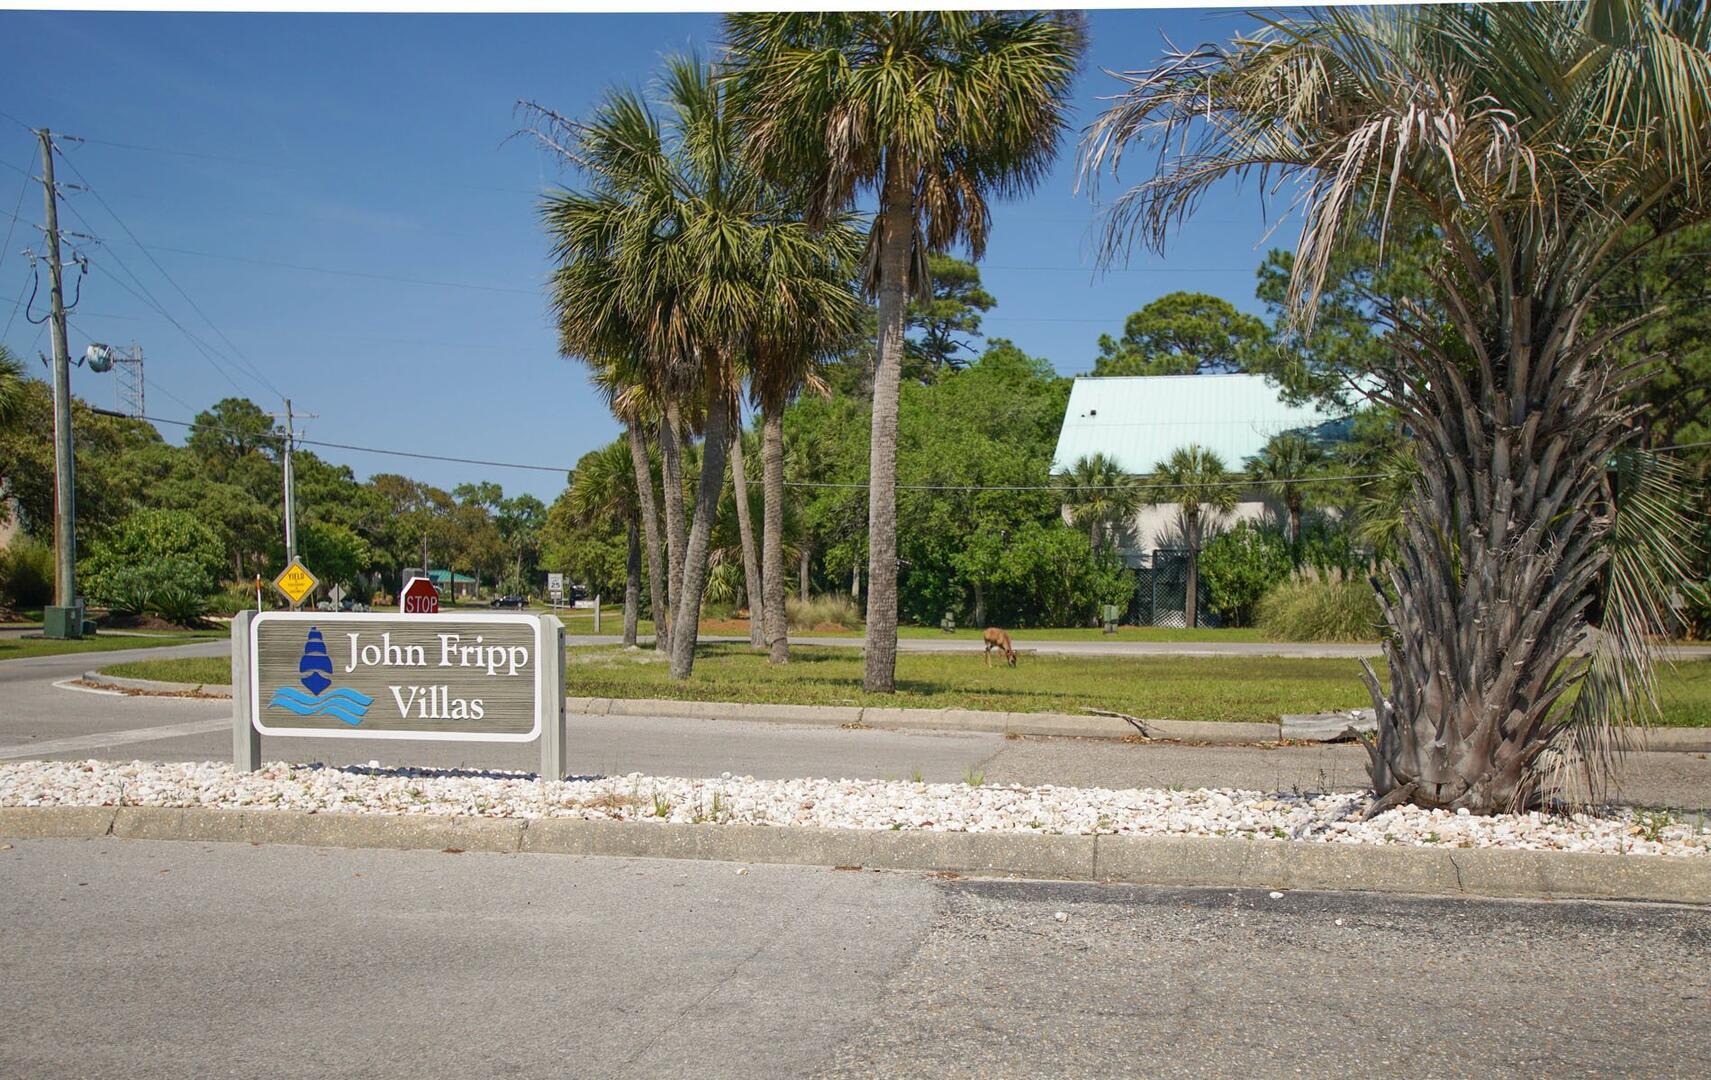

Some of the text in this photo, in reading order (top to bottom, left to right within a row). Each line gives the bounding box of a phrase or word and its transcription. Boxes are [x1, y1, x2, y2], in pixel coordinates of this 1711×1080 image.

[288, 572, 305, 580] YIELD
[406, 595, 438, 613] STOP
[345, 632, 529, 676] John Fripp
[388, 685, 485, 720] Villas
